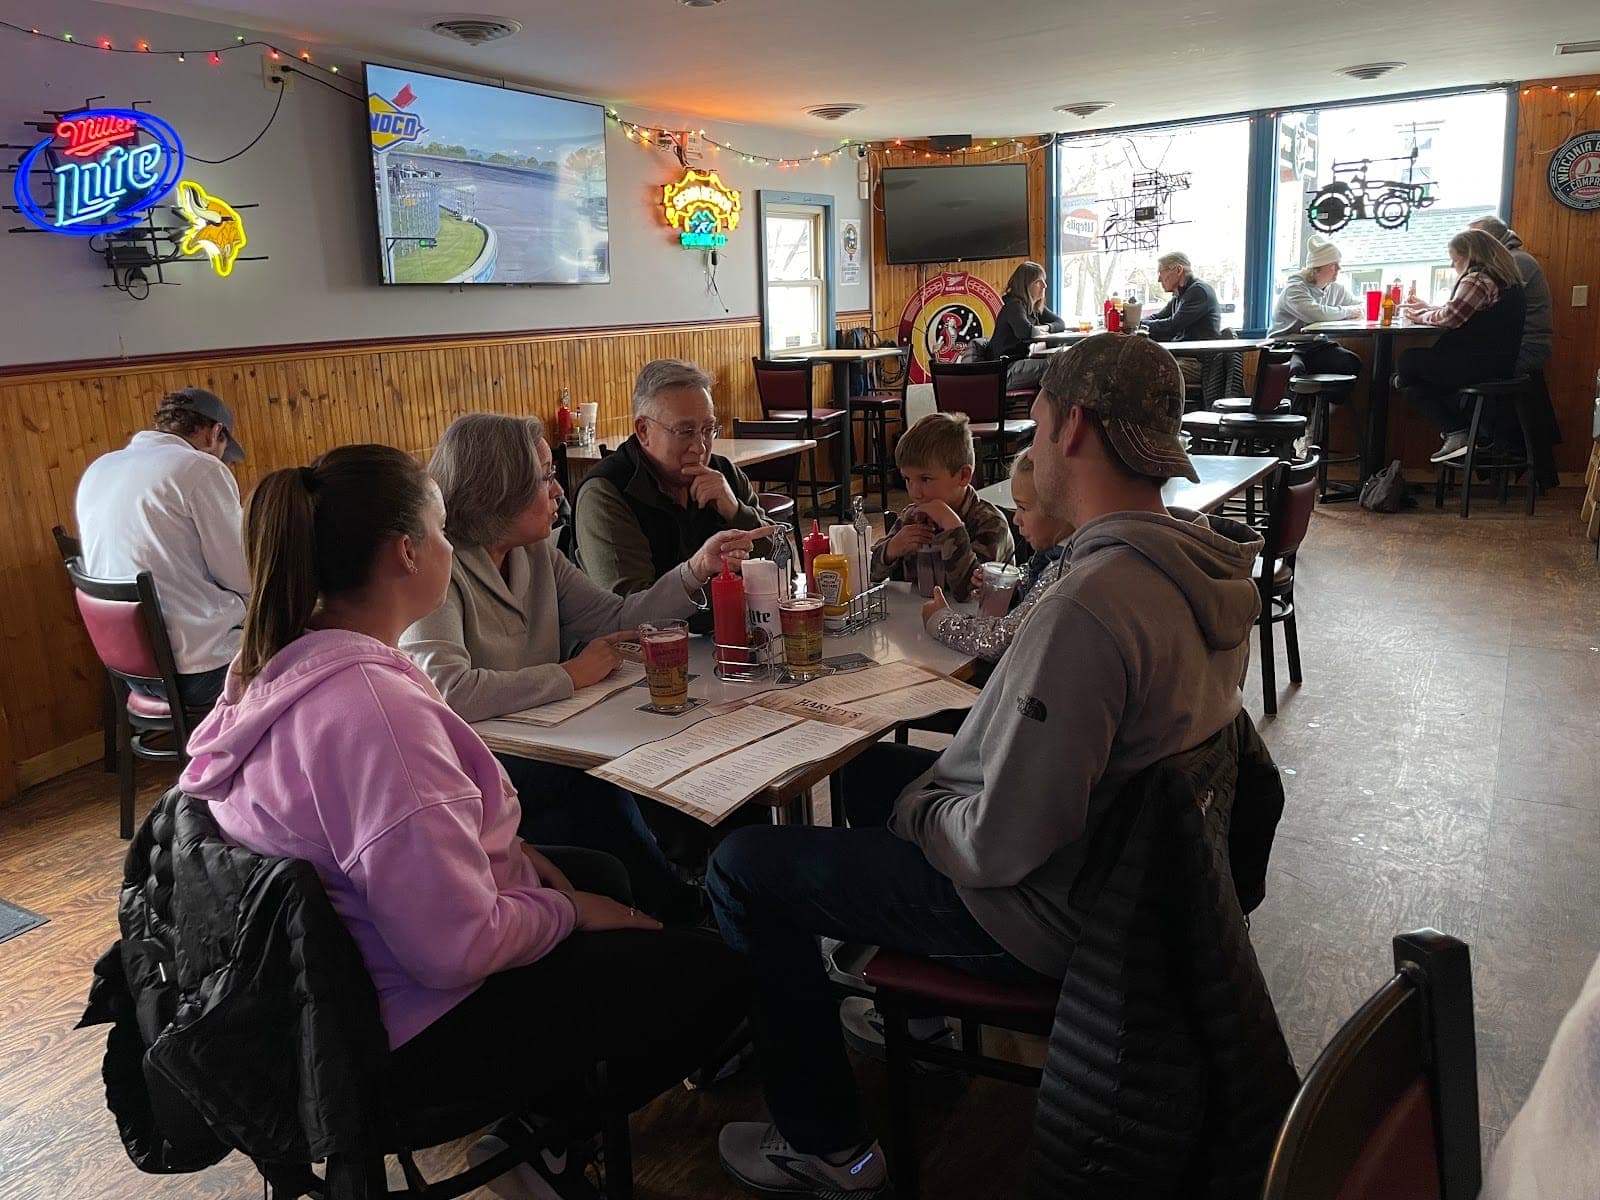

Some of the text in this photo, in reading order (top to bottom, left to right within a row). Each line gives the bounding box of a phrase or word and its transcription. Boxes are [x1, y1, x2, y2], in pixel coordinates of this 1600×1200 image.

[56, 116, 137, 151] Miller
[1557, 141, 1592, 184] WACONIA
[55, 144, 162, 228] Lite
